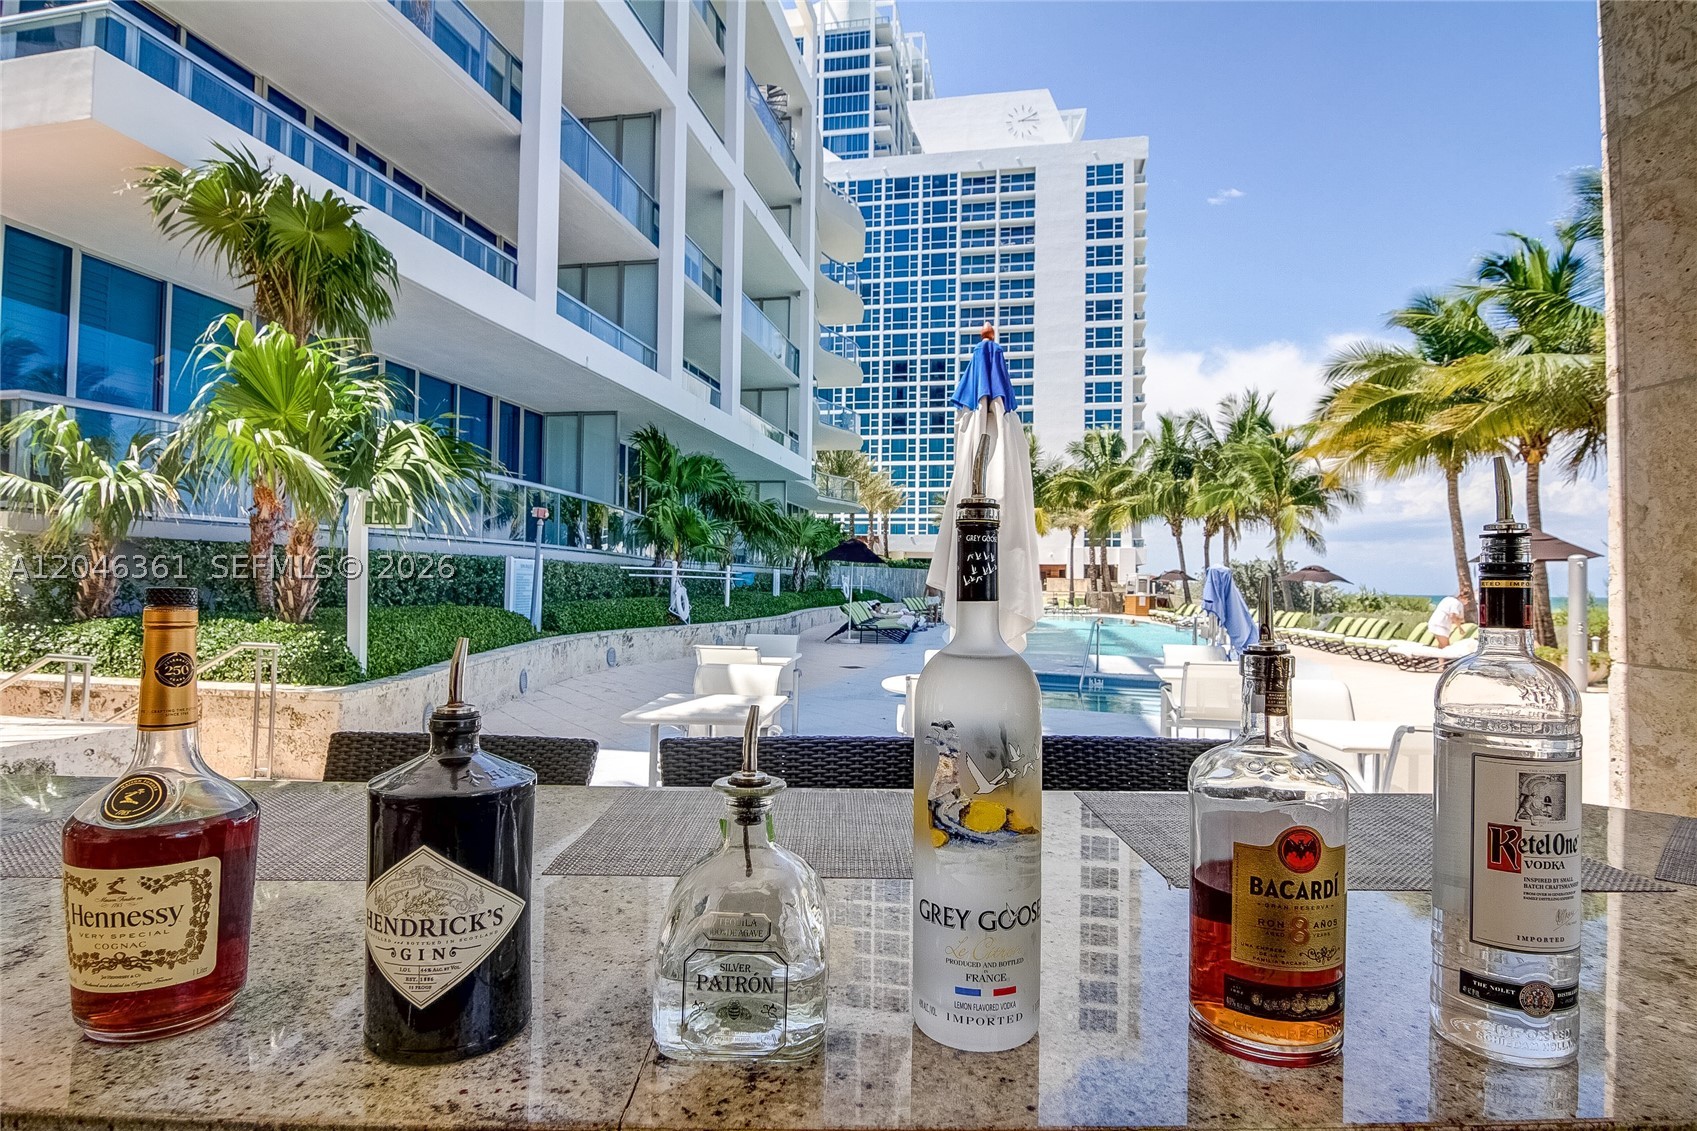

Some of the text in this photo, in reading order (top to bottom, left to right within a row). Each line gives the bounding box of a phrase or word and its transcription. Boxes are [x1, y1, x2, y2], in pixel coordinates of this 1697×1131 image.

[965, 534, 981, 542] GREY
[164, 665, 190, 676] 250
[1524, 860, 1565, 870] VODKA
[1523, 876, 1553, 884] INSPIRED
[1250, 872, 1339, 900] BACARDÍ
[71, 903, 185, 928] Hennessy
[919, 898, 1041, 932] GREY GOOSE
[366, 907, 504, 937] HENDRICK'S
[1258, 918, 1338, 929] RON AÑOS
[111, 929, 170, 939] SPECIAL
[459, 930, 499, 942] SCOTLAND
[738, 929, 764, 937] AGAVE
[1290, 916, 1311, 947] 8
[1516, 935, 1565, 943] IMPORTED
[94, 941, 147, 950] COGNAC
[400, 948, 445, 961] GIN
[719, 963, 751, 972] SILVER
[945, 957, 982, 968] PRODUCED
[998, 957, 1025, 968] BOTTLED
[196, 966, 208, 975] Liter
[696, 972, 775, 993] PATRÓN
[965, 973, 1007, 983] FRANCE
[1472, 979, 1488, 989] THE
[1489, 985, 1516, 995] NOLET
[954, 1001, 1017, 1011] LEMON FLAVORED VODKA
[946, 1012, 1024, 1026] IMPORTED
